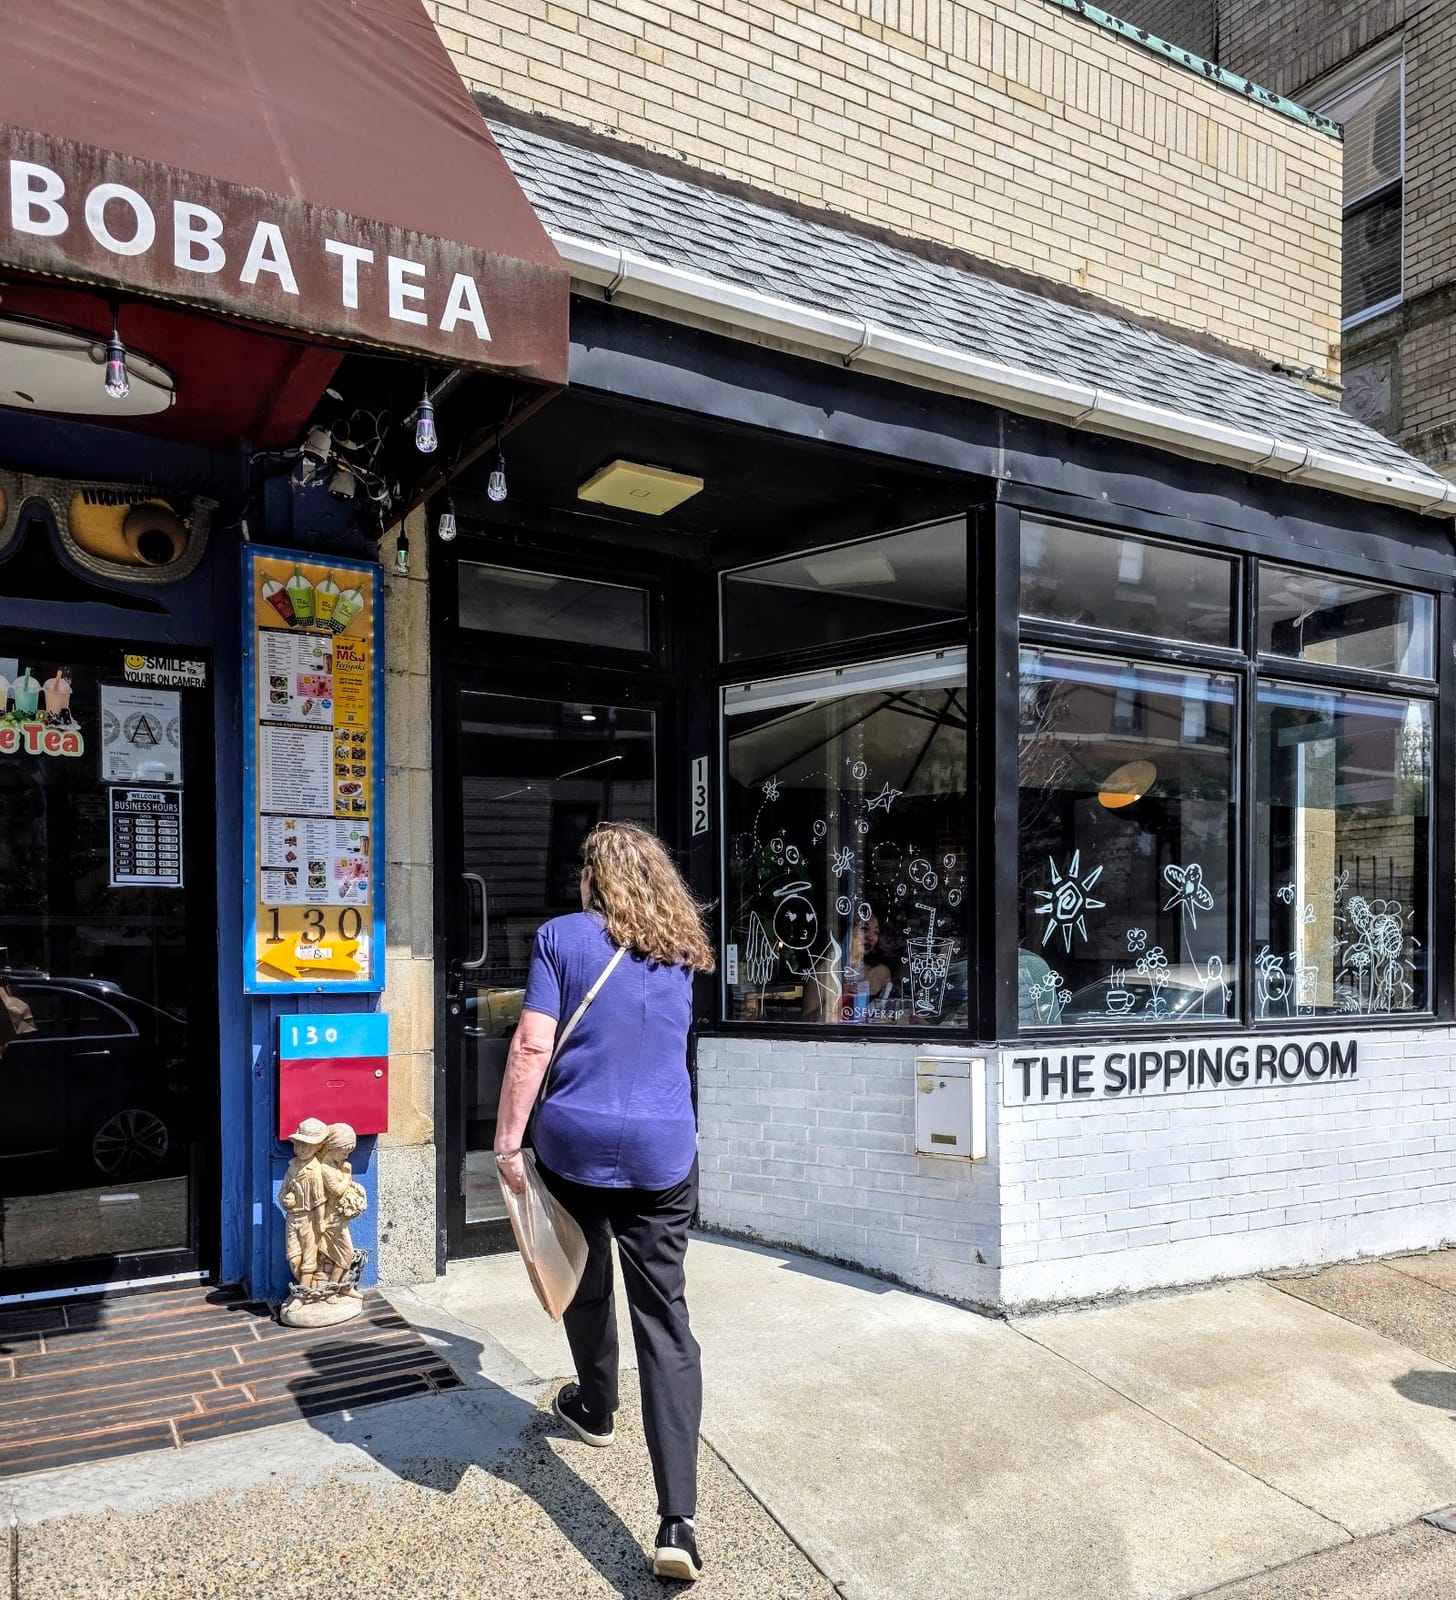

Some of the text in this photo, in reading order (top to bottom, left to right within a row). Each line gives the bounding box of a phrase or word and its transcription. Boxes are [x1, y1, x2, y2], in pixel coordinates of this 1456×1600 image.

[10, 159, 492, 342] BOBA TEA
[146, 656, 186, 673] SMILE
[336, 650, 366, 662] M&J
[125, 671, 206, 688] YOU'RE ON CAMERA
[22, 723, 81, 754] Tea
[131, 792, 161, 800] WELCOME
[694, 759, 706, 833] 132
[114, 801, 178, 813] BUSINESS HOURS
[266, 907, 363, 943] 130
[291, 1026, 338, 1047] 130
[1013, 1039, 1358, 1097] THE SIPPING ROOM
